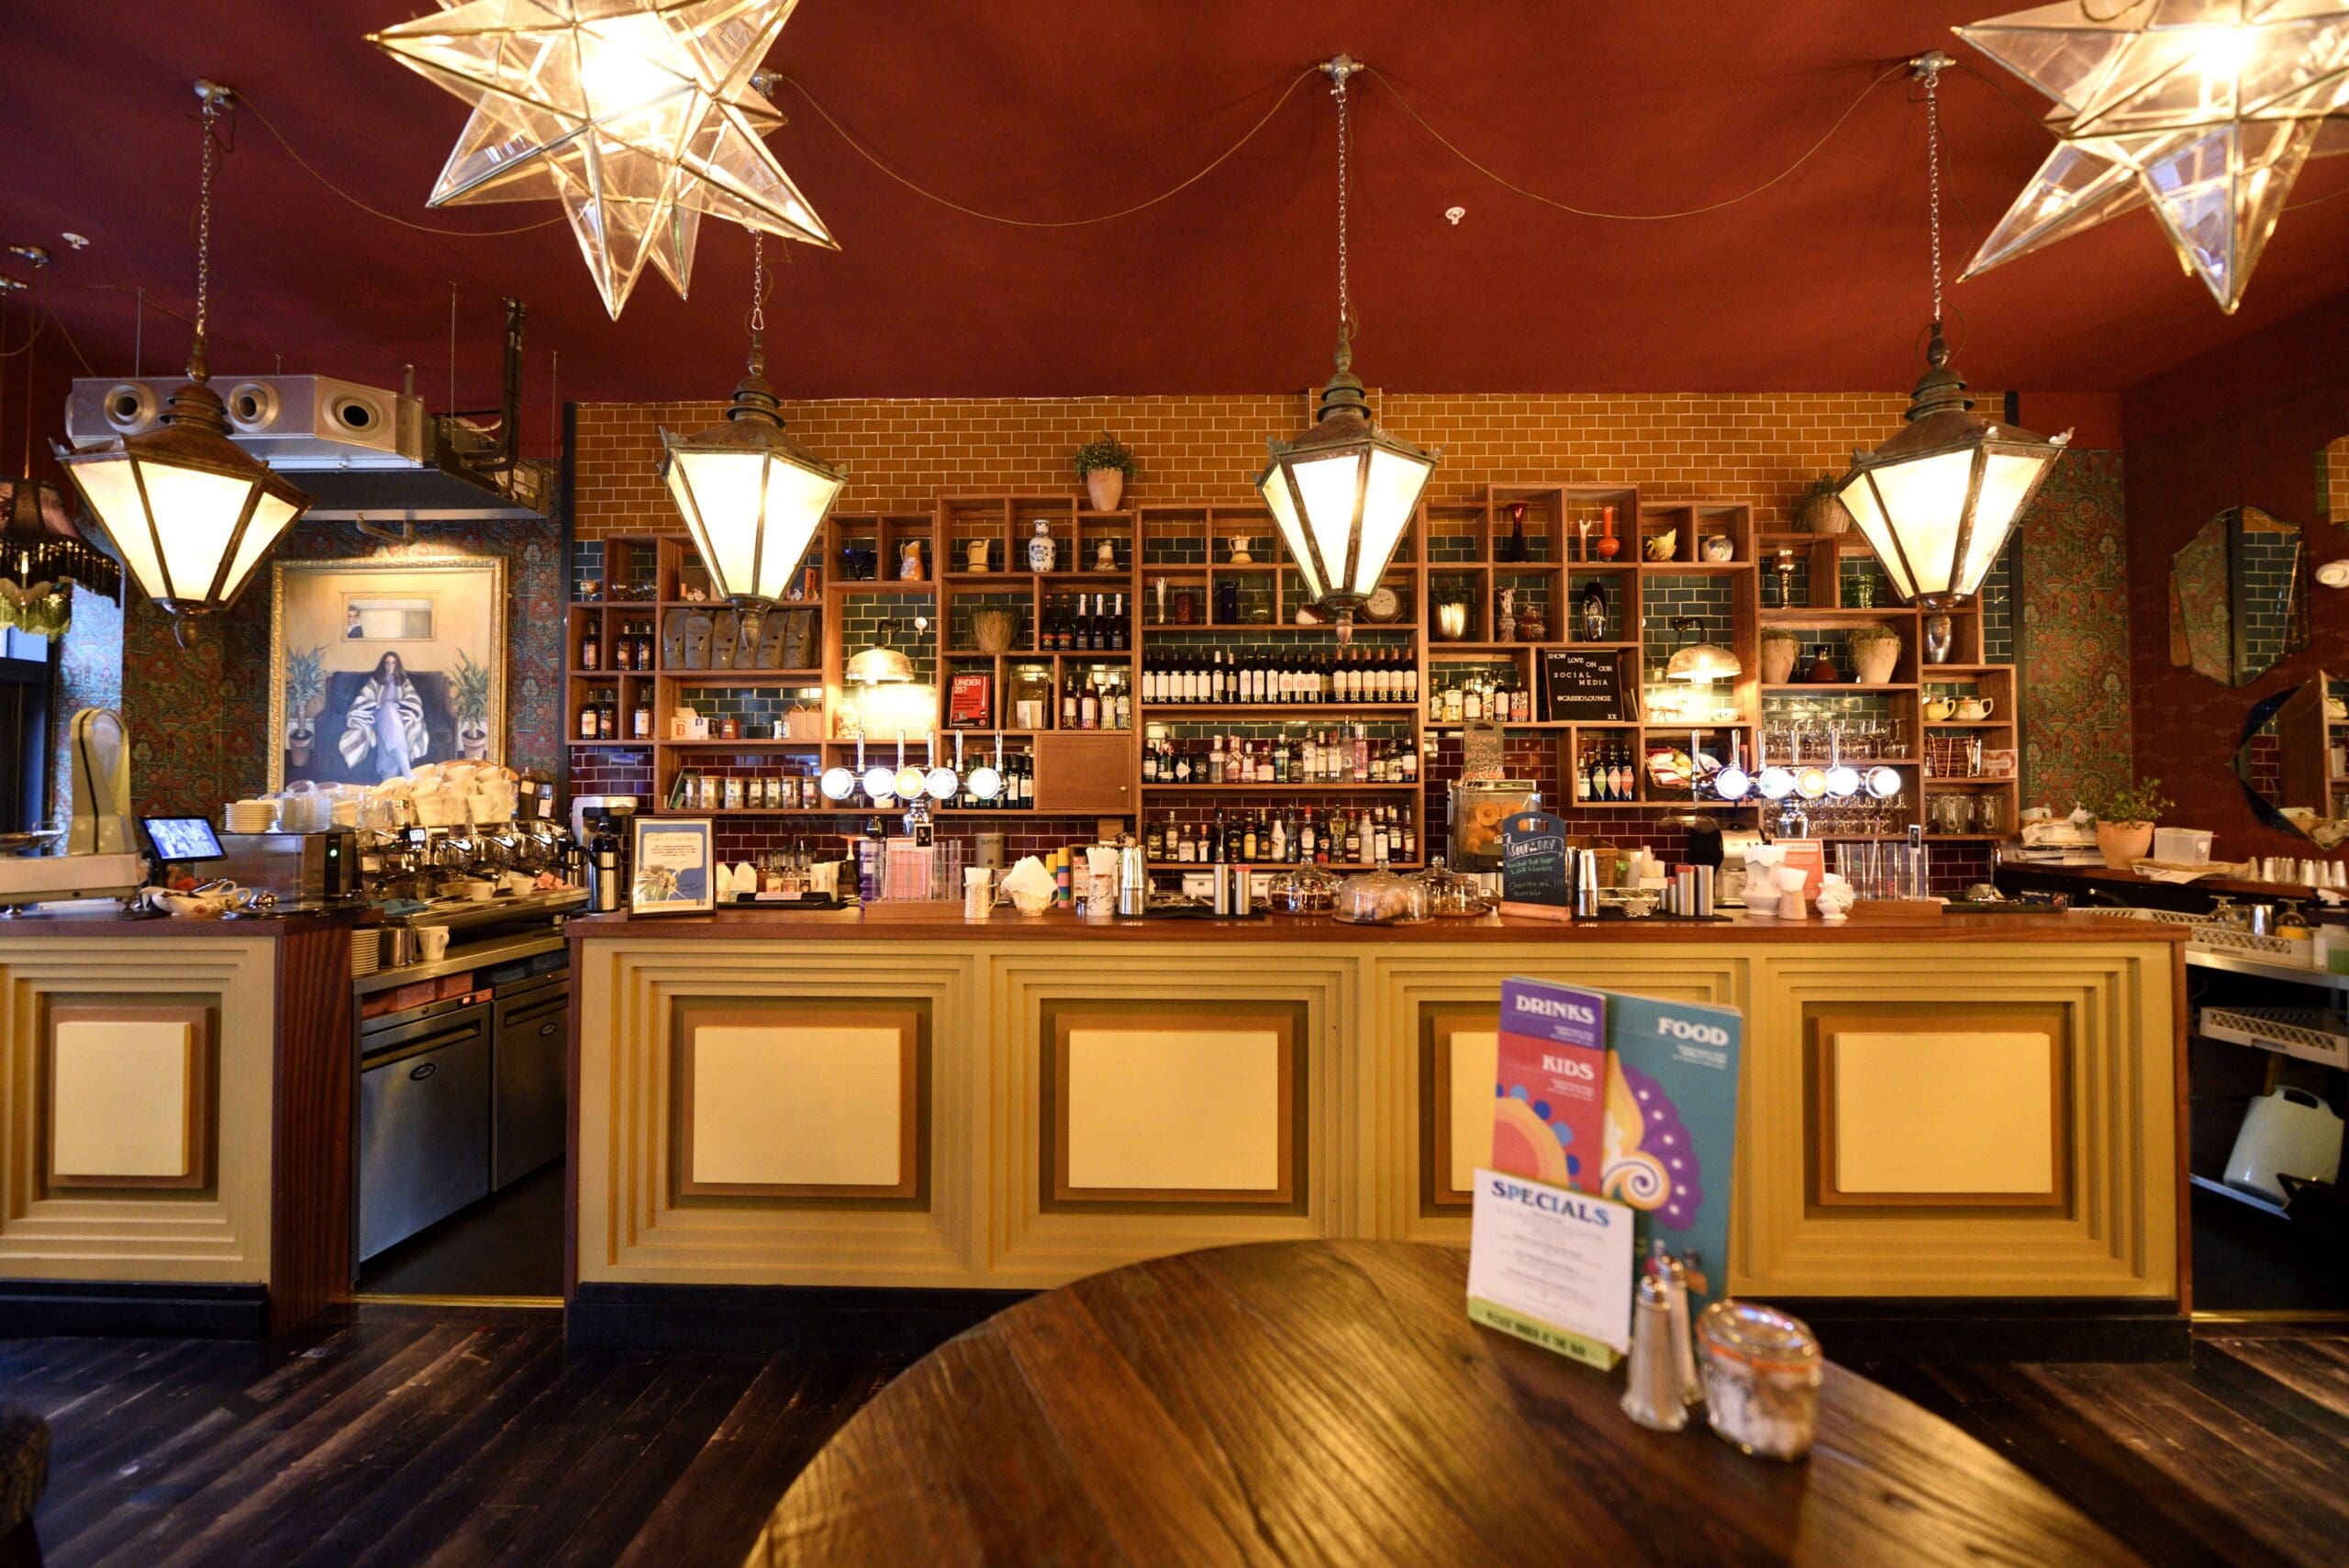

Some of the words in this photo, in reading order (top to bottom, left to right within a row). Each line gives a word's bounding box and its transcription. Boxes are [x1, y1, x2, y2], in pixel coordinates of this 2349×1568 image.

[1508, 843, 1529, 857] SOUP
[1537, 839, 1556, 851] DAY
[1516, 995, 1595, 1025] DRINKS
[1658, 1017, 1730, 1047] FOOD
[1542, 1054, 1595, 1081] KIDS
[1492, 1180, 1610, 1228] SPECIALS
